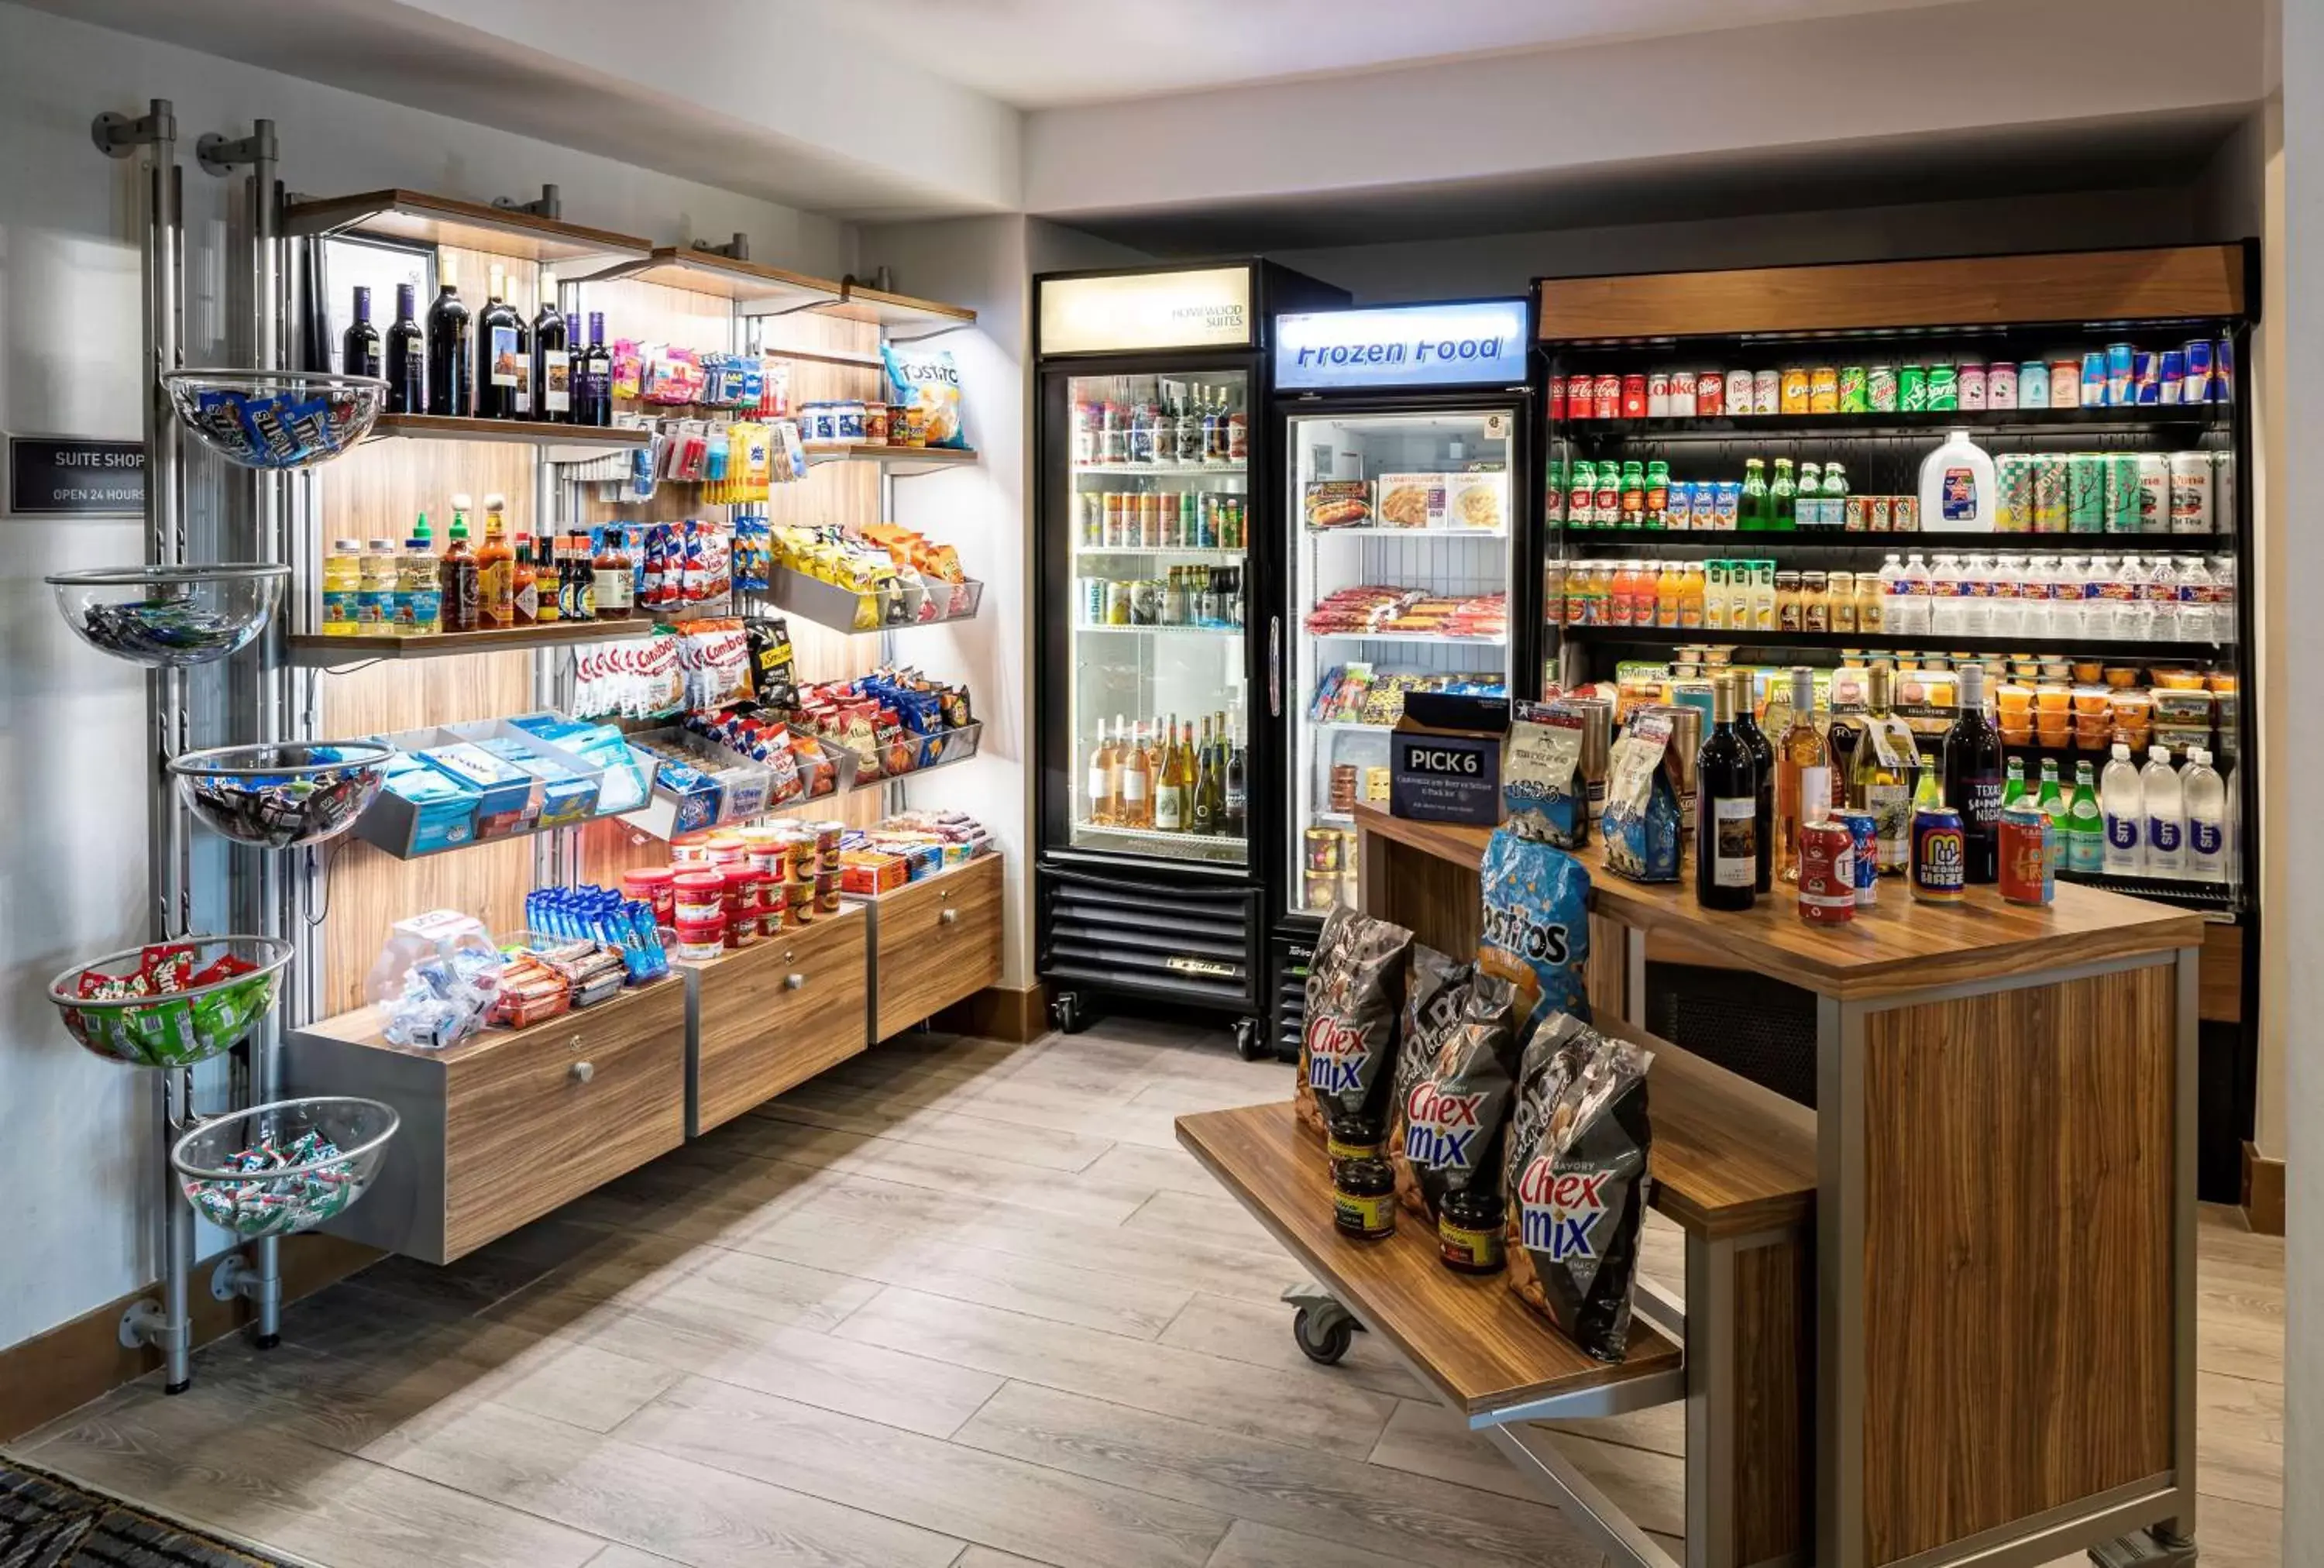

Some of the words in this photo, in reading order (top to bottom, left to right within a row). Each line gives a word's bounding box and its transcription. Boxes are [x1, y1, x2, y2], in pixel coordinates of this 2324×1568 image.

[1298, 341, 1406, 366] Frozen
[1415, 335, 1503, 362] Food
[55, 452, 101, 466] SUITE
[104, 453, 145, 467] SHOP
[53, 489, 87, 500] OPEN
[91, 489, 103, 500] 24
[106, 489, 144, 500] HOURS
[1411, 749, 1462, 772] PICK
[1463, 754, 1477, 773] 6
[1921, 872, 1964, 885] HAZE
[1309, 1016, 1367, 1055] Chex
[1310, 1055, 1364, 1093] mix
[1408, 1081, 1480, 1126] Chex
[1407, 1126, 1473, 1167] mix
[1518, 1157, 1608, 1210] Chex
[1524, 1208, 1600, 1259] mix
